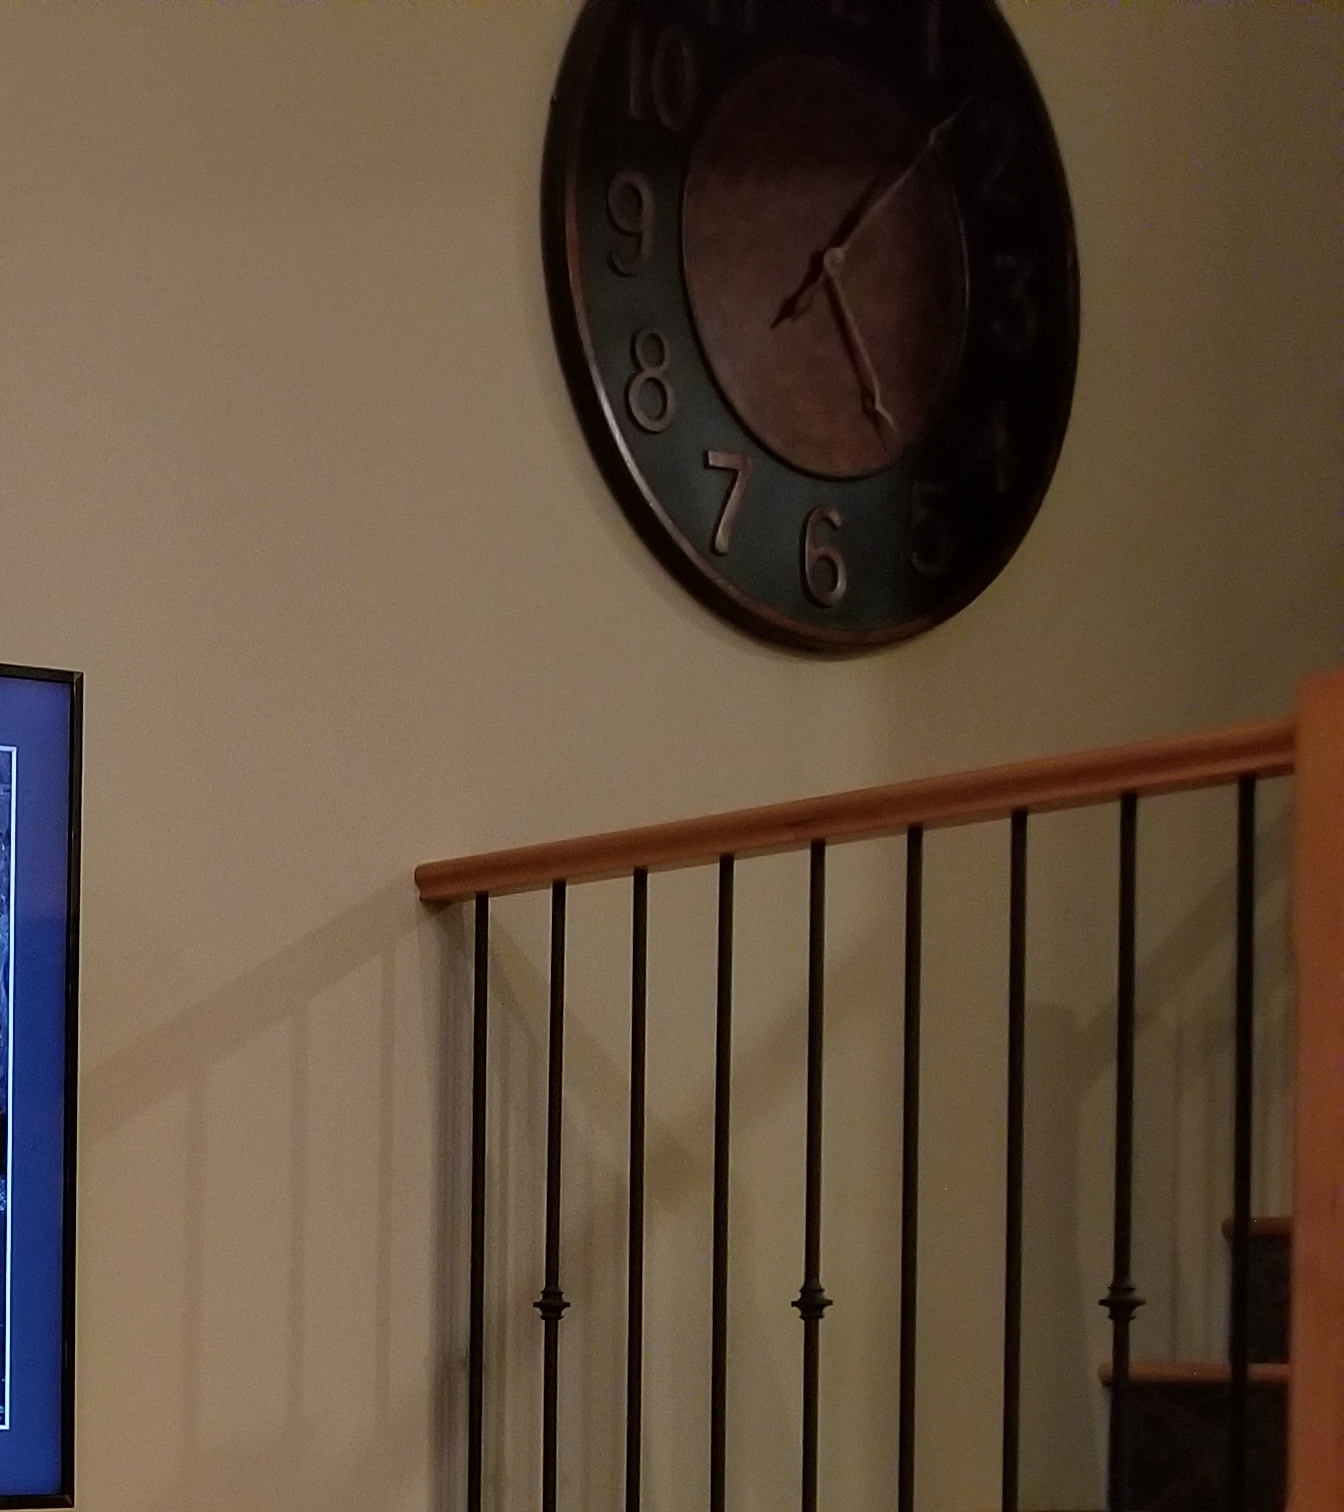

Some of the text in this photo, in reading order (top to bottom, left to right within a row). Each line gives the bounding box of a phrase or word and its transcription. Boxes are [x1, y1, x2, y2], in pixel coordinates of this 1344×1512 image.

[627, 16, 697, 132] 10
[605, 170, 655, 278] 9
[624, 326, 678, 435] 8
[703, 449, 755, 558] 7
[798, 505, 848, 610] 6
